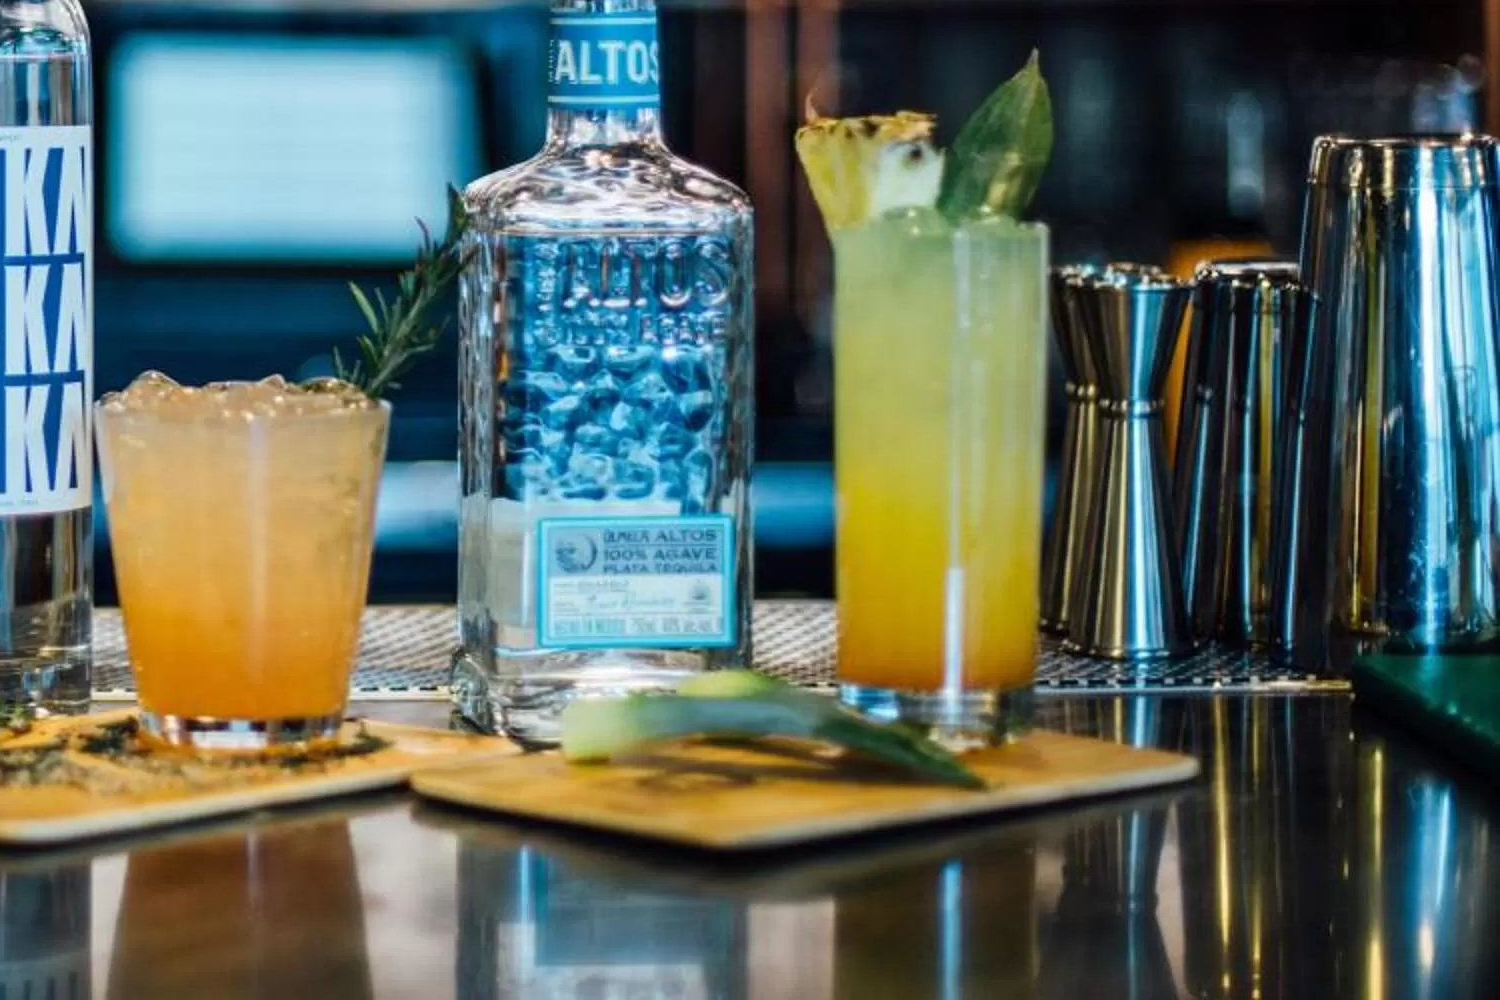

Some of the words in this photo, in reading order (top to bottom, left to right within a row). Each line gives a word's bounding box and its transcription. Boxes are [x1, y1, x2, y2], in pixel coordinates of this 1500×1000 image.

[555, 40, 659, 85] ALTOS
[656, 529, 717, 542] ALTOS
[603, 548, 648, 561] 100%
[654, 547, 717, 561] AGAVE
[655, 563, 718, 575] TEQUILA
